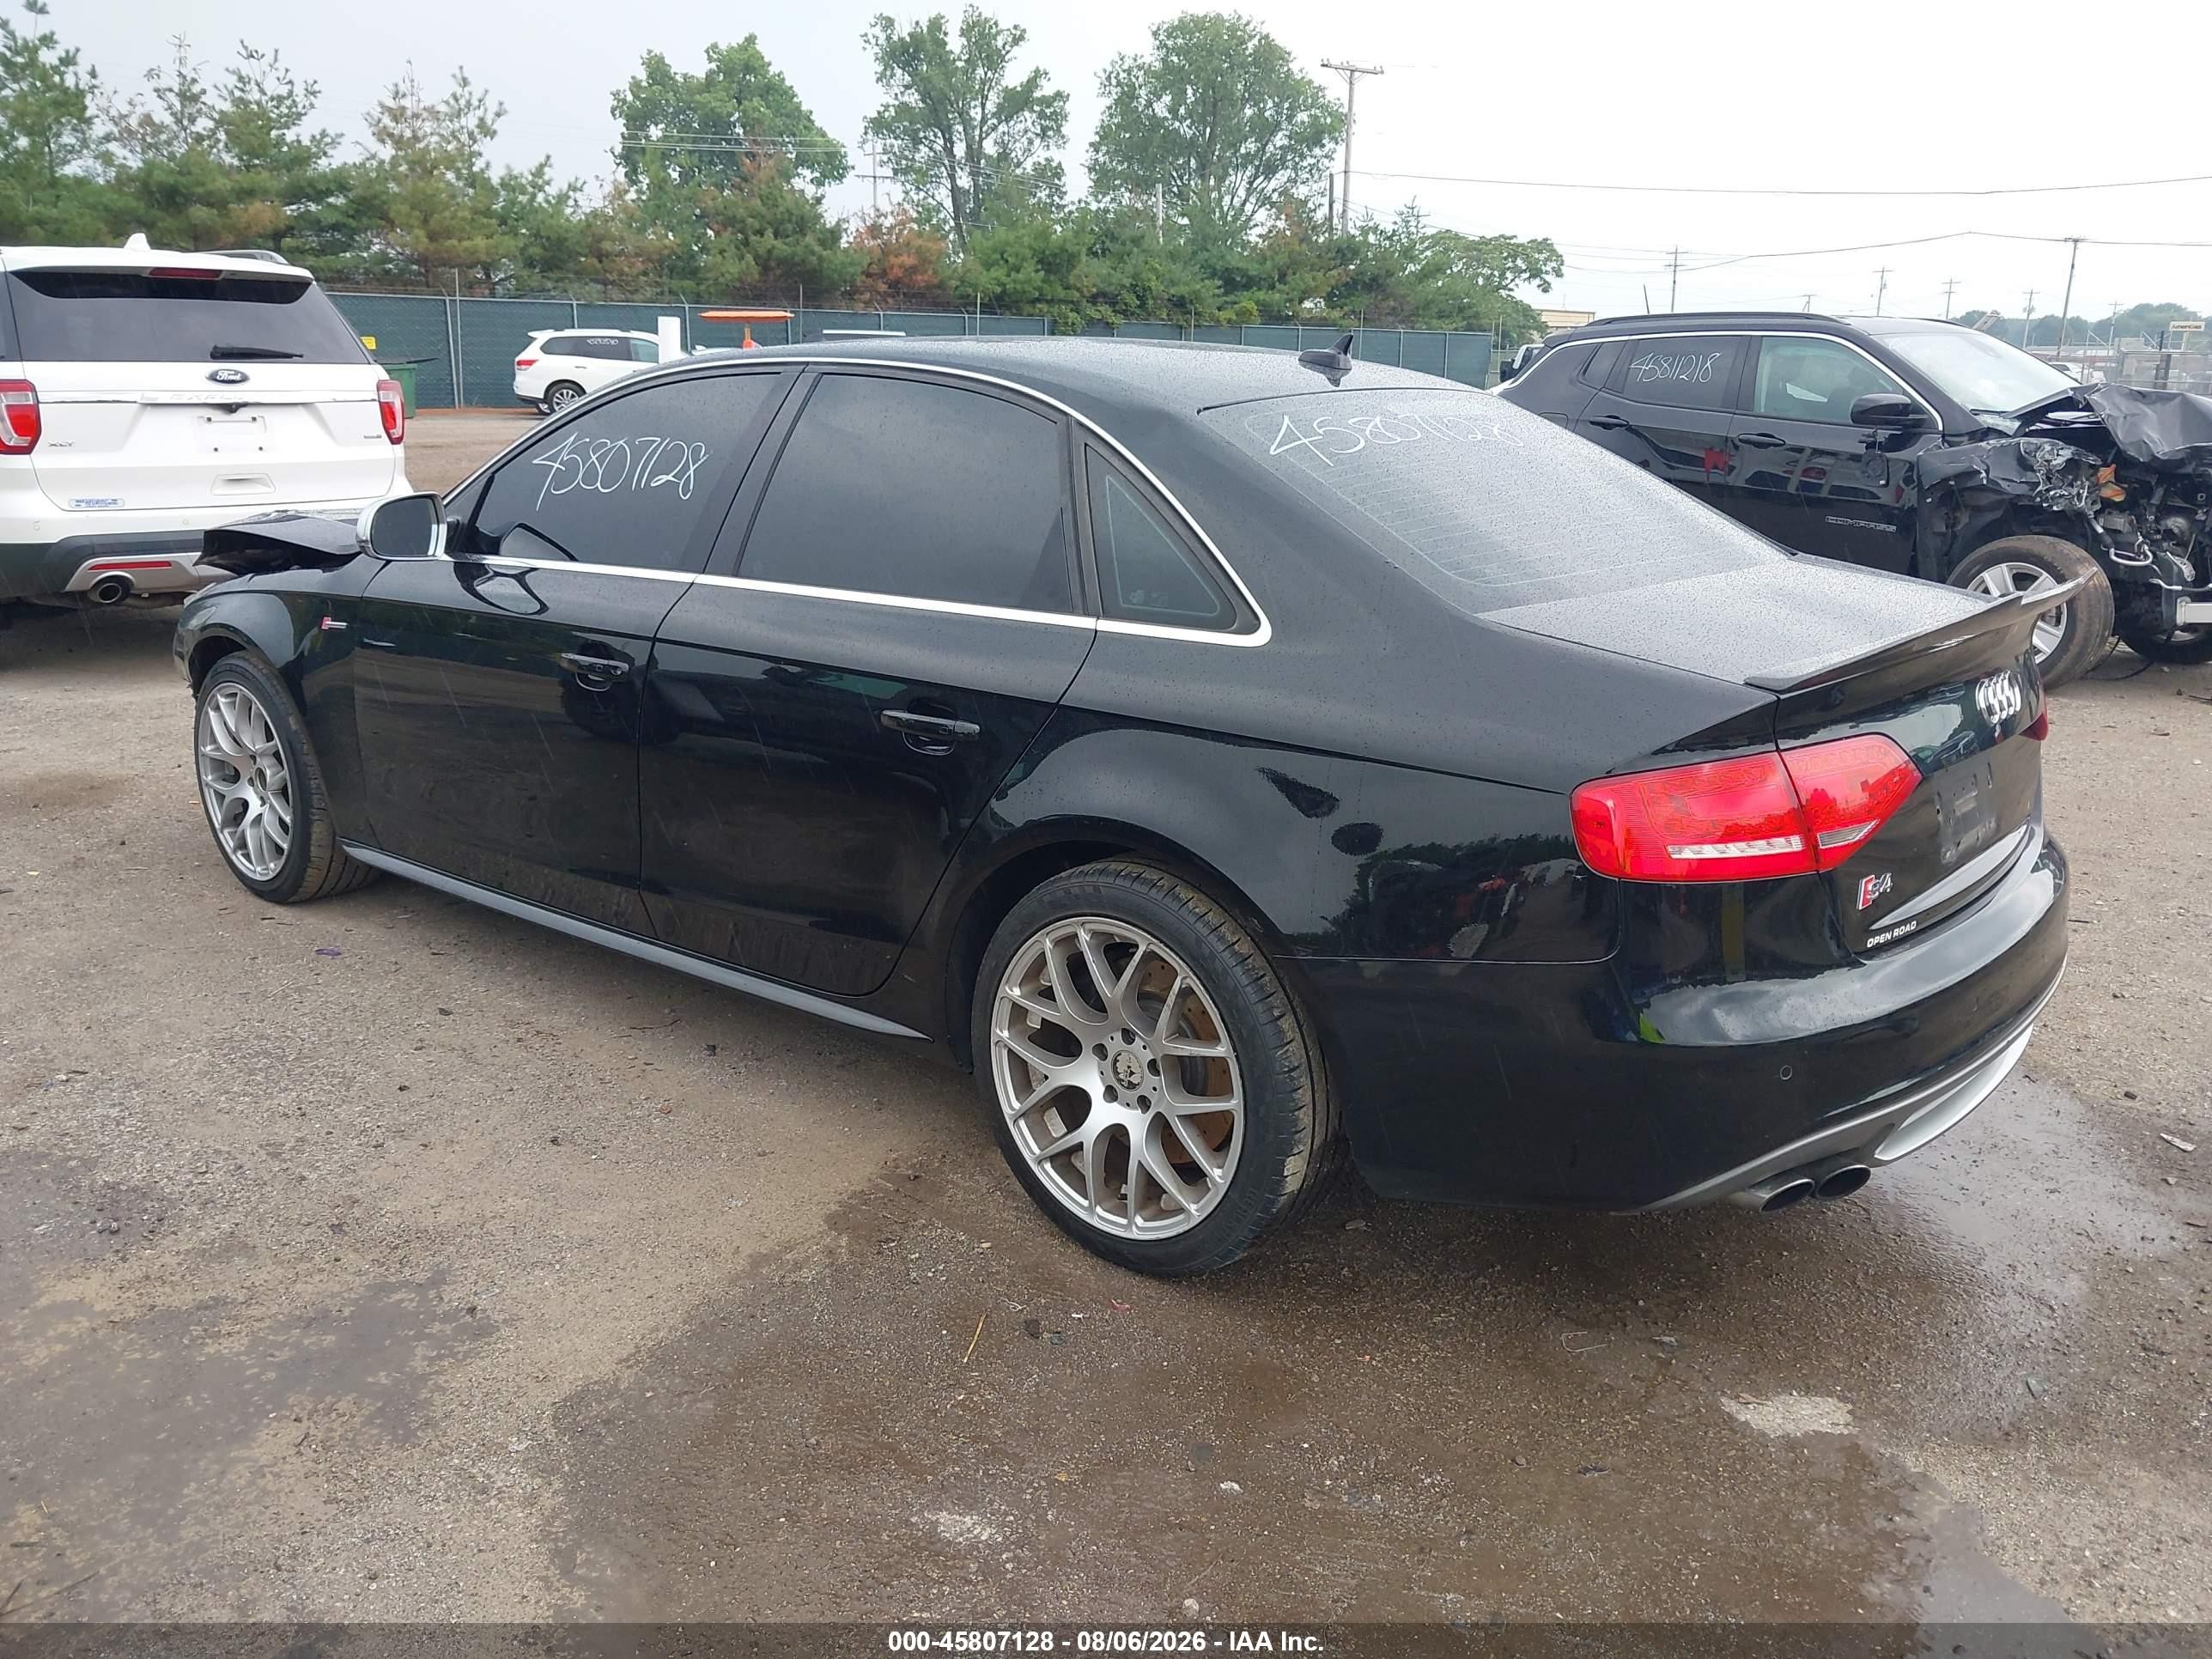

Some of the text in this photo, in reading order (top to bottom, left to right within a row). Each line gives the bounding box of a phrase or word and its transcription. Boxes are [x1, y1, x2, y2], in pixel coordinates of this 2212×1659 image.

[216, 370, 241, 380] Ford
[1628, 352, 1722, 383] 45811218
[47, 439, 76, 447] XLT
[532, 432, 713, 512] 45807128
[1825, 515, 1897, 533] COMPASS
[1867, 920, 1917, 948] OPEN ROAD
